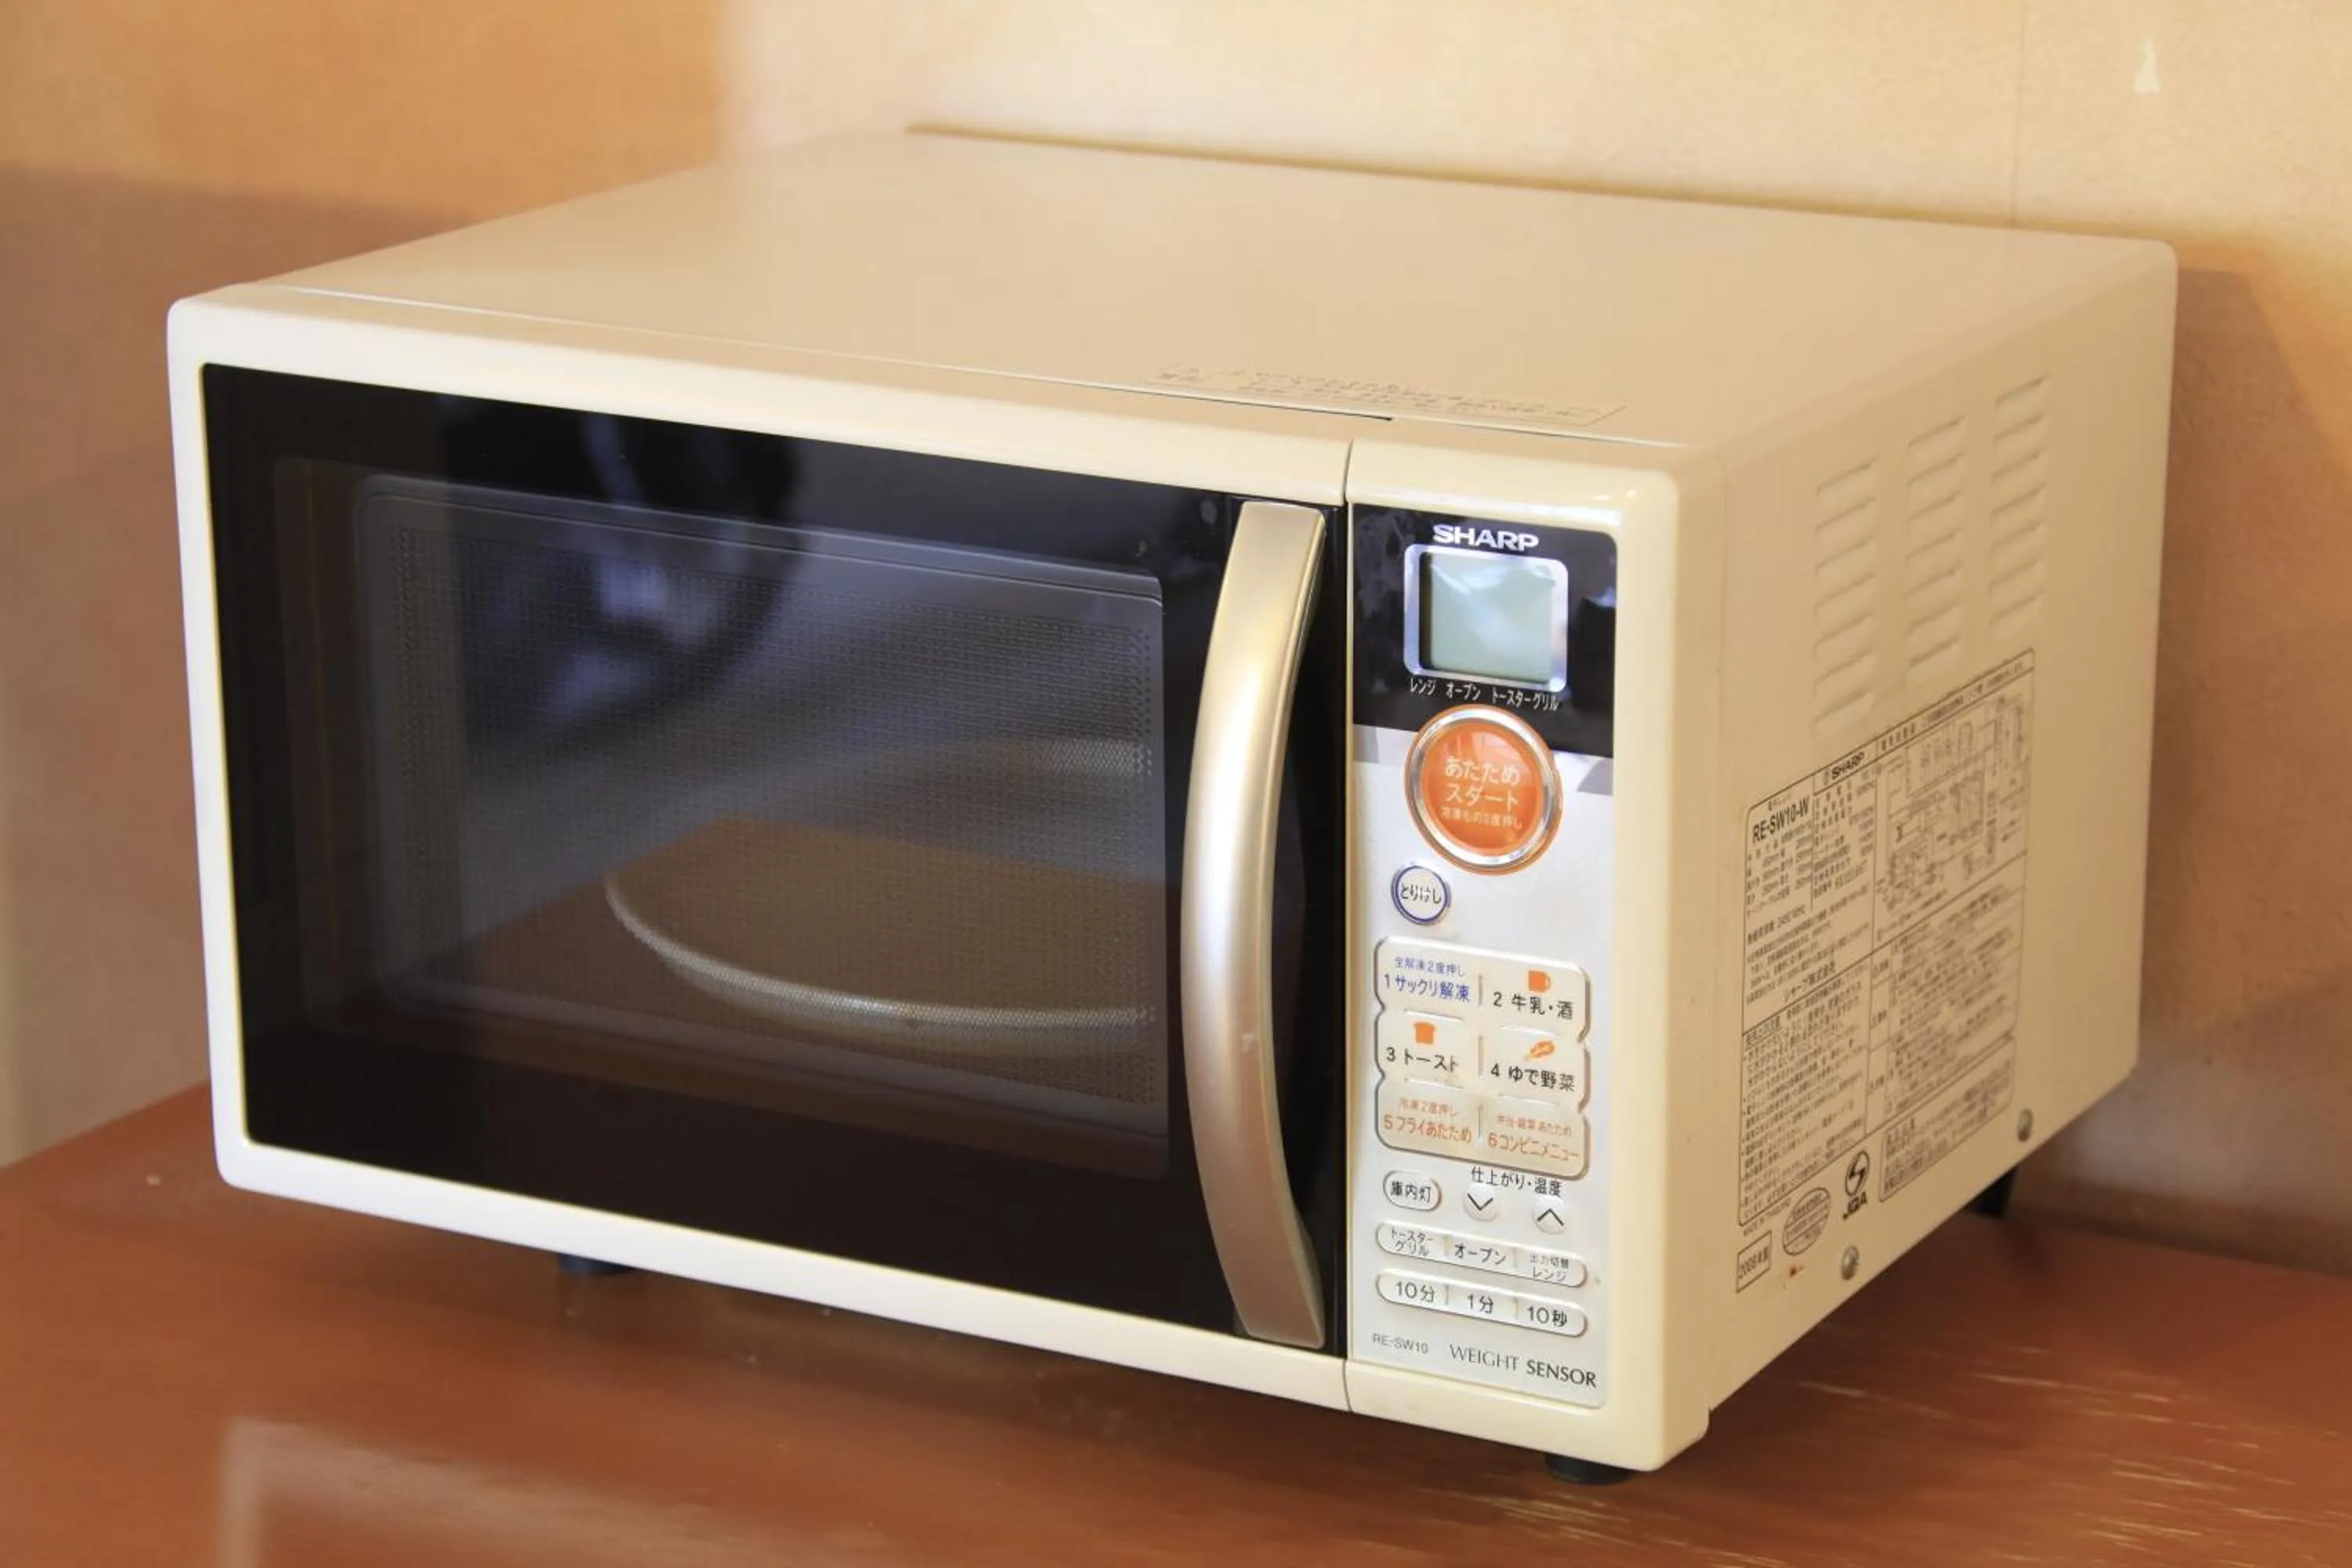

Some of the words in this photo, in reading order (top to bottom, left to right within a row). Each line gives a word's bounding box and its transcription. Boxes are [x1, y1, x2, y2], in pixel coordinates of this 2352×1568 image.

[1432, 523, 1540, 552] SHARP
[1410, 677, 1436, 695] レンジ
[1446, 681, 1481, 701] オープン
[1444, 755, 1521, 786] あたため
[1831, 751, 1865, 781] SHARP
[1446, 783, 1519, 811] スタート
[1752, 795, 1810, 845] RE-SW10-W
[1401, 884, 1443, 905] とりけし
[1493, 992, 1503, 1007] 2
[1404, 1048, 1459, 1073] トースト
[1490, 1063, 1501, 1078] 4
[1508, 1065, 1576, 1092] ゆで野菜
[1390, 1180, 1433, 1203] 庫内灯
[1395, 1240, 1430, 1256] グリル
[1454, 1243, 1507, 1266] オープン
[1533, 1266, 1567, 1282] レンジ
[1394, 1280, 1436, 1303] 10分
[1467, 1293, 1494, 1315] 1分
[1526, 1306, 1569, 1328] 10秒
[1372, 1332, 1429, 1355] RE-SW10
[1449, 1343, 1520, 1372] WEIGHT
[1526, 1359, 1598, 1388] SENSOR
